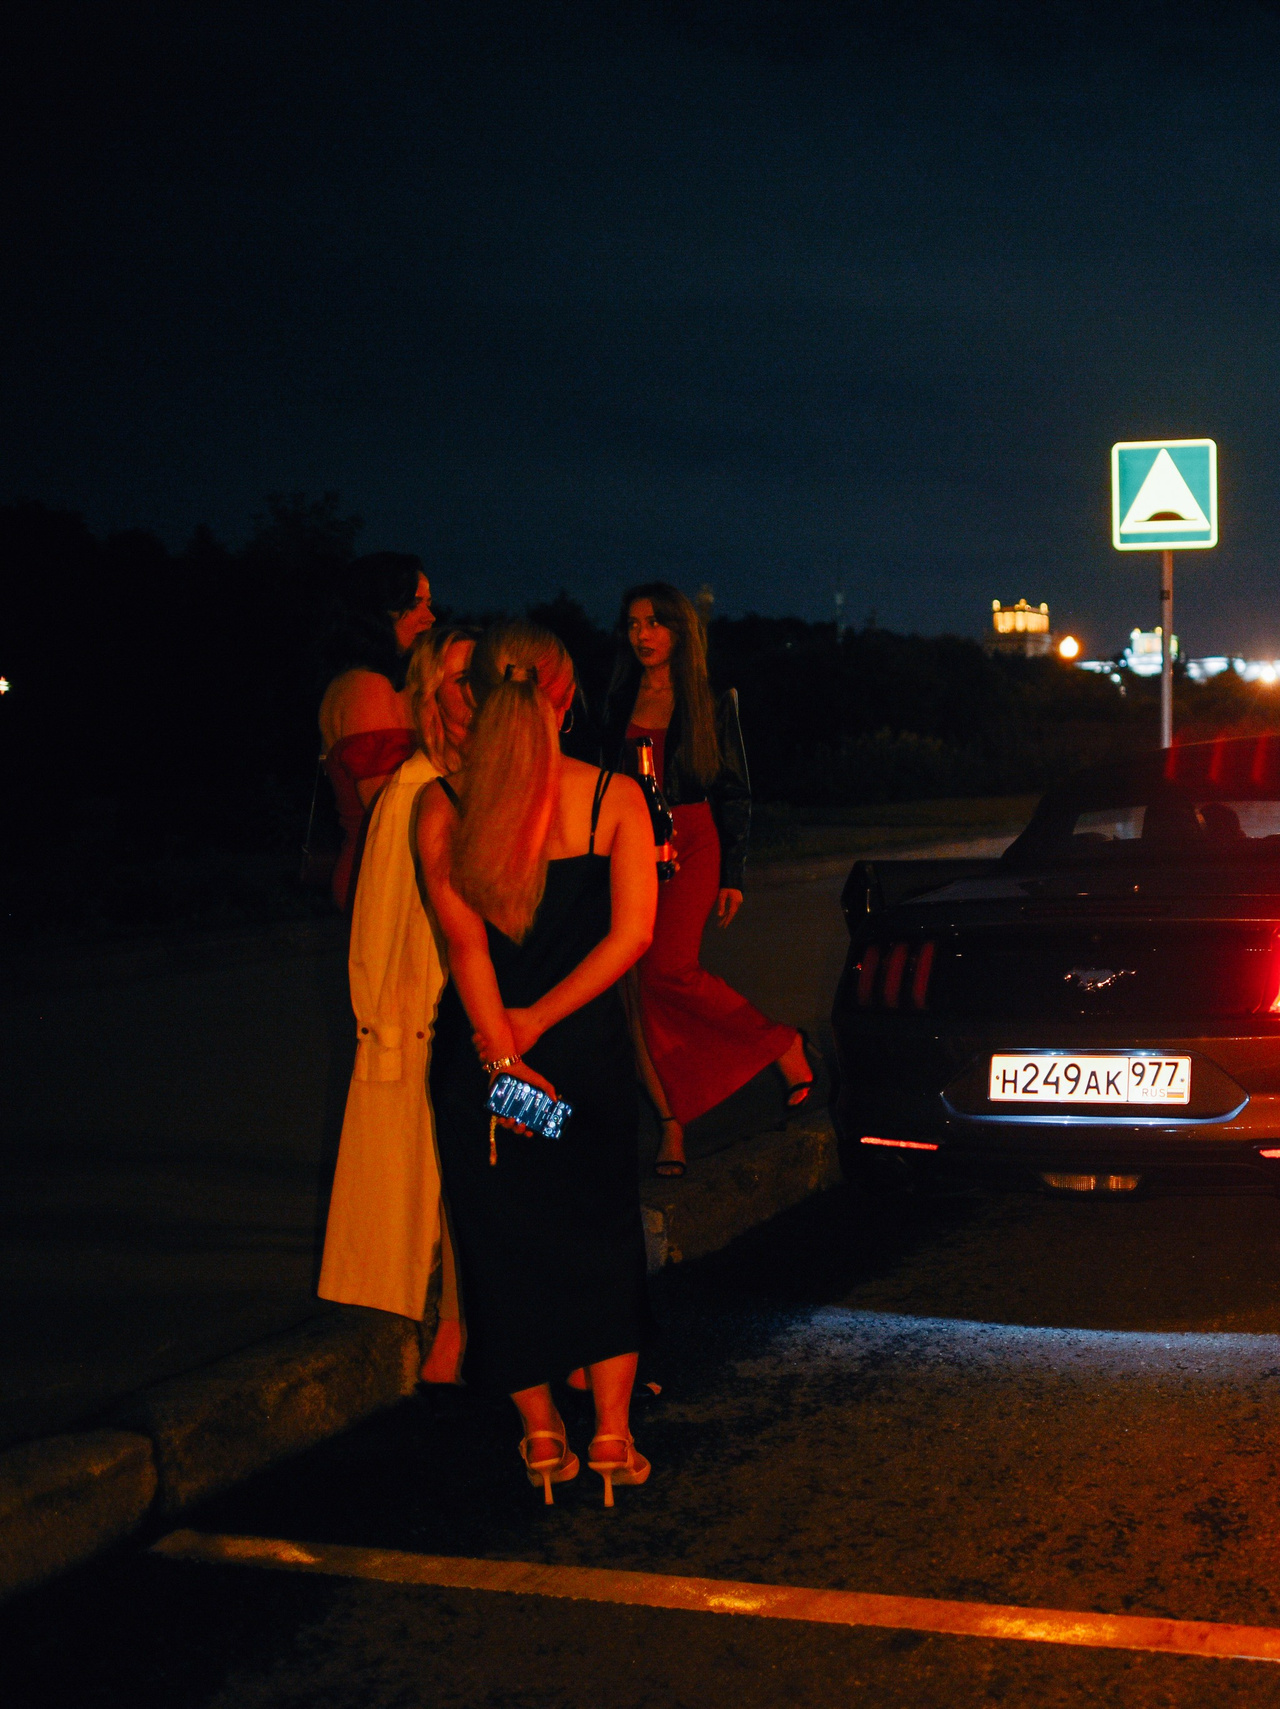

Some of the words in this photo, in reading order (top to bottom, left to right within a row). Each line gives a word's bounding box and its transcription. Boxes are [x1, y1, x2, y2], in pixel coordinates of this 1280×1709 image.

[1001, 1062, 1123, 1096] Н249АК
[1131, 1061, 1180, 1087] 977
[1141, 1087, 1166, 1098] RUS
